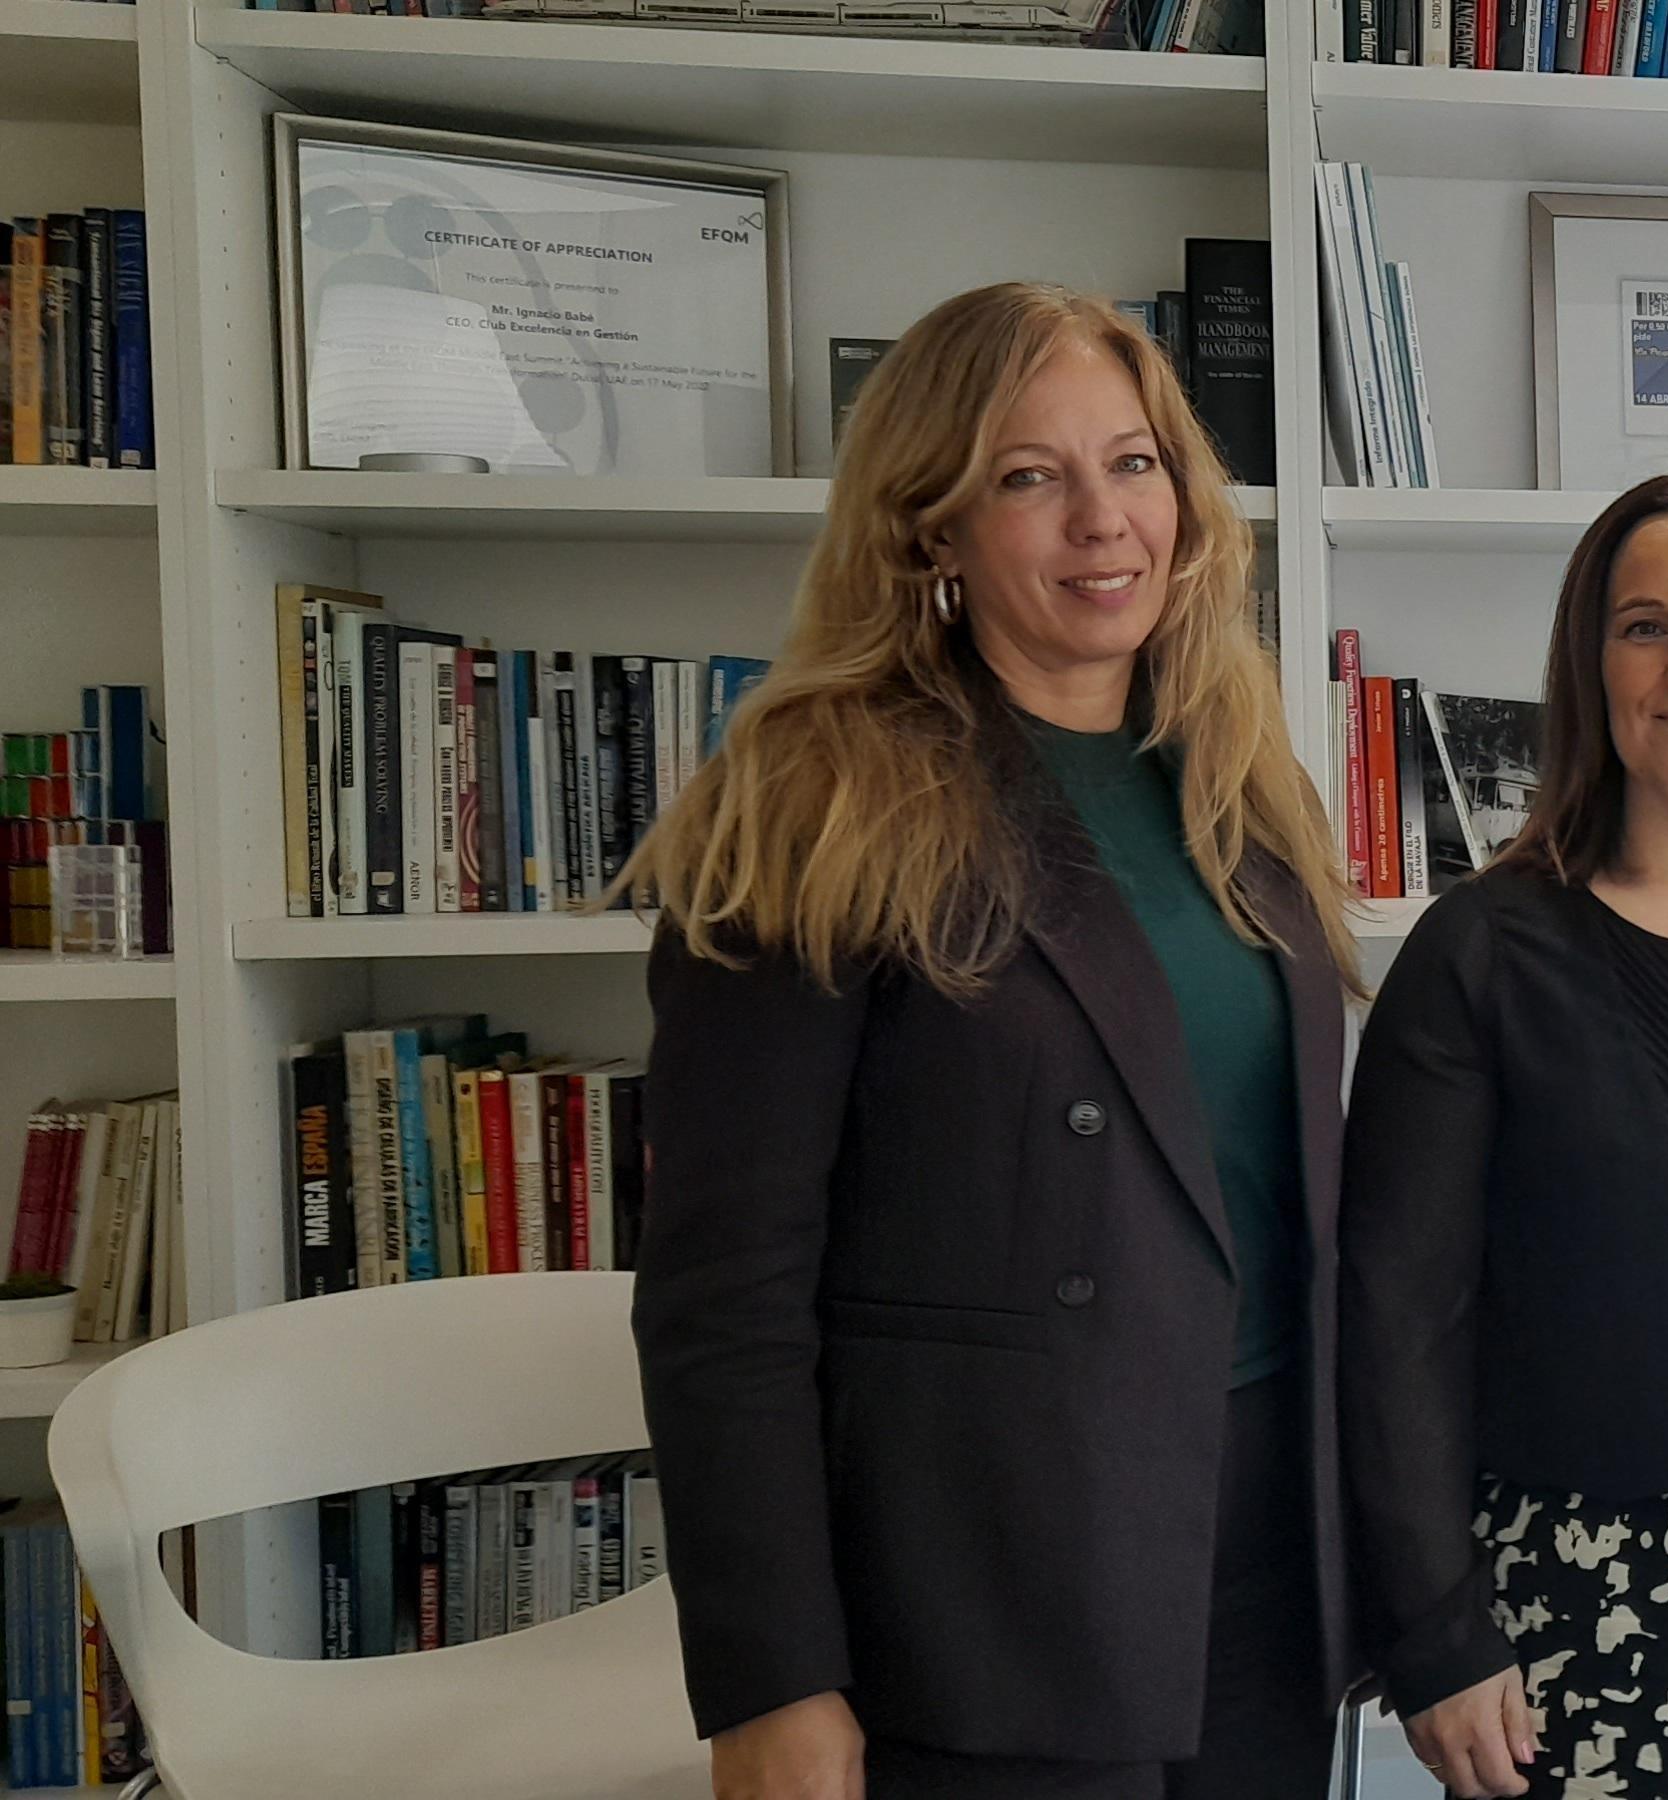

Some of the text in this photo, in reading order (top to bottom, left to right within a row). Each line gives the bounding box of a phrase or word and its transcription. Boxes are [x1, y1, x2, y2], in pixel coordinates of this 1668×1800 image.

[1360, 28, 1377, 59] Value
[423, 230, 653, 264] CERTIFICATE OF APPRECIATION
[700, 227, 750, 246] EFQM
[491, 305, 513, 317] Mr.
[516, 307, 561, 320] Ignacio
[1202, 295, 1262, 305] FINANCIAL
[1216, 304, 1250, 314] TIMES
[478, 319, 506, 331] Club
[510, 322, 572, 336] Excelencia
[575, 327, 590, 337] en
[593, 328, 639, 342] Gestión
[1198, 324, 1270, 338] HANDBOOK
[92, 352, 105, 371] and
[1198, 342, 1271, 358] MANAGEMENT
[1635, 393, 1647, 404] 14
[1366, 380, 1385, 464] Informe Integrado
[1343, 636, 1359, 759] Quality Function Deployment
[341, 707, 353, 750] QUALITY
[371, 635, 389, 816] QUALITY PROBLEM SOLVING
[1404, 820, 1413, 838] FILO
[1377, 834, 1388, 882] Apenas 20
[1414, 835, 1422, 867] NAVAJA
[409, 860, 422, 902] AENOR
[297, 1105, 330, 1247] MARCA ESPAÑA
[573, 1543, 598, 1599] Leading
